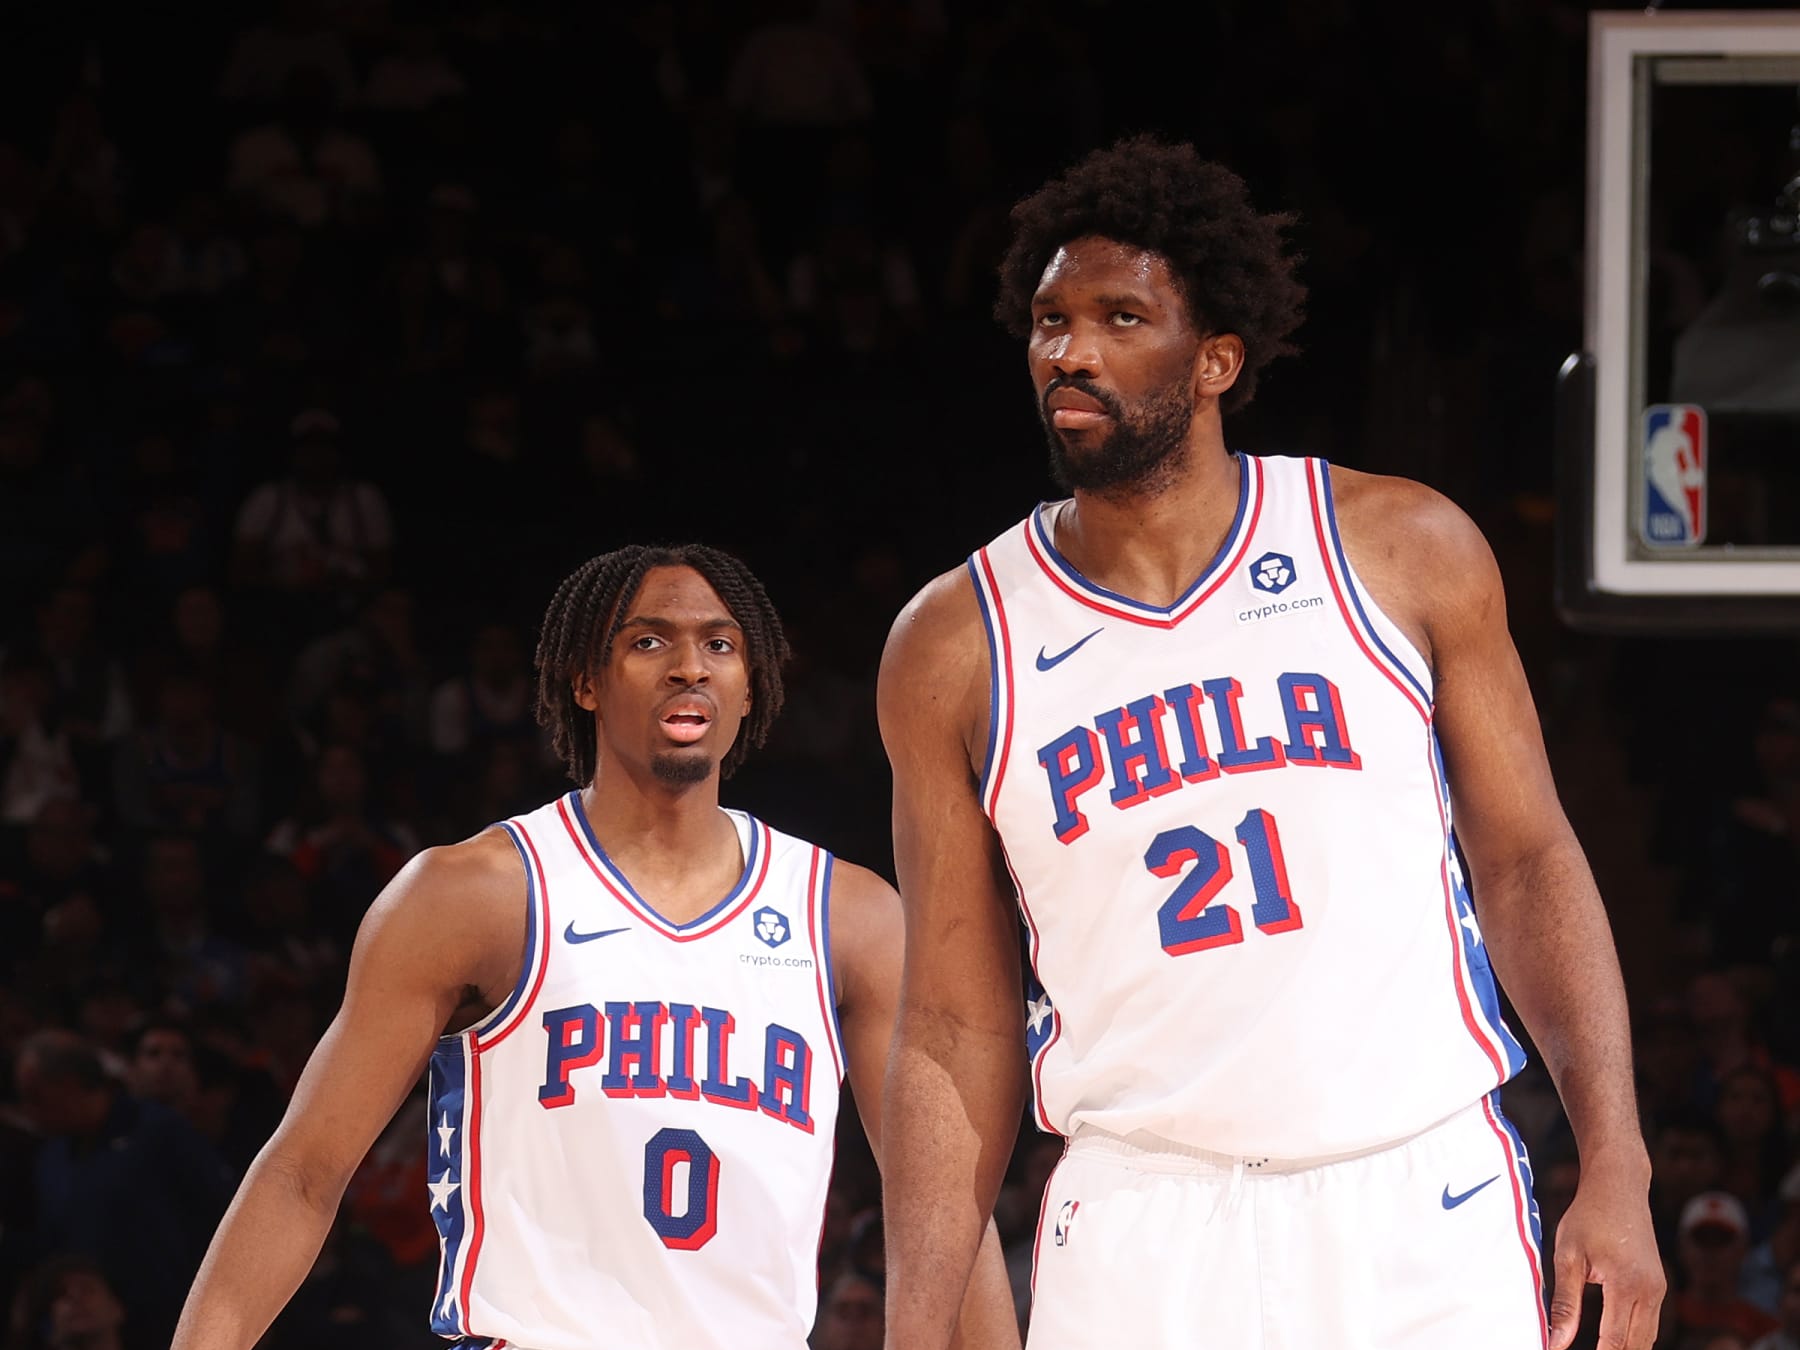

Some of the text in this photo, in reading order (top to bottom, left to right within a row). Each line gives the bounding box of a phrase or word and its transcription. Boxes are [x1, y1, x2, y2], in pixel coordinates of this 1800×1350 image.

[1239, 597, 1324, 621] crypto.com
[1037, 672, 1362, 845] PHILA
[1144, 808, 1303, 957] 21
[739, 953, 813, 968] crypto.com
[538, 1001, 815, 1136] PHILA
[644, 1128, 720, 1250] 0
